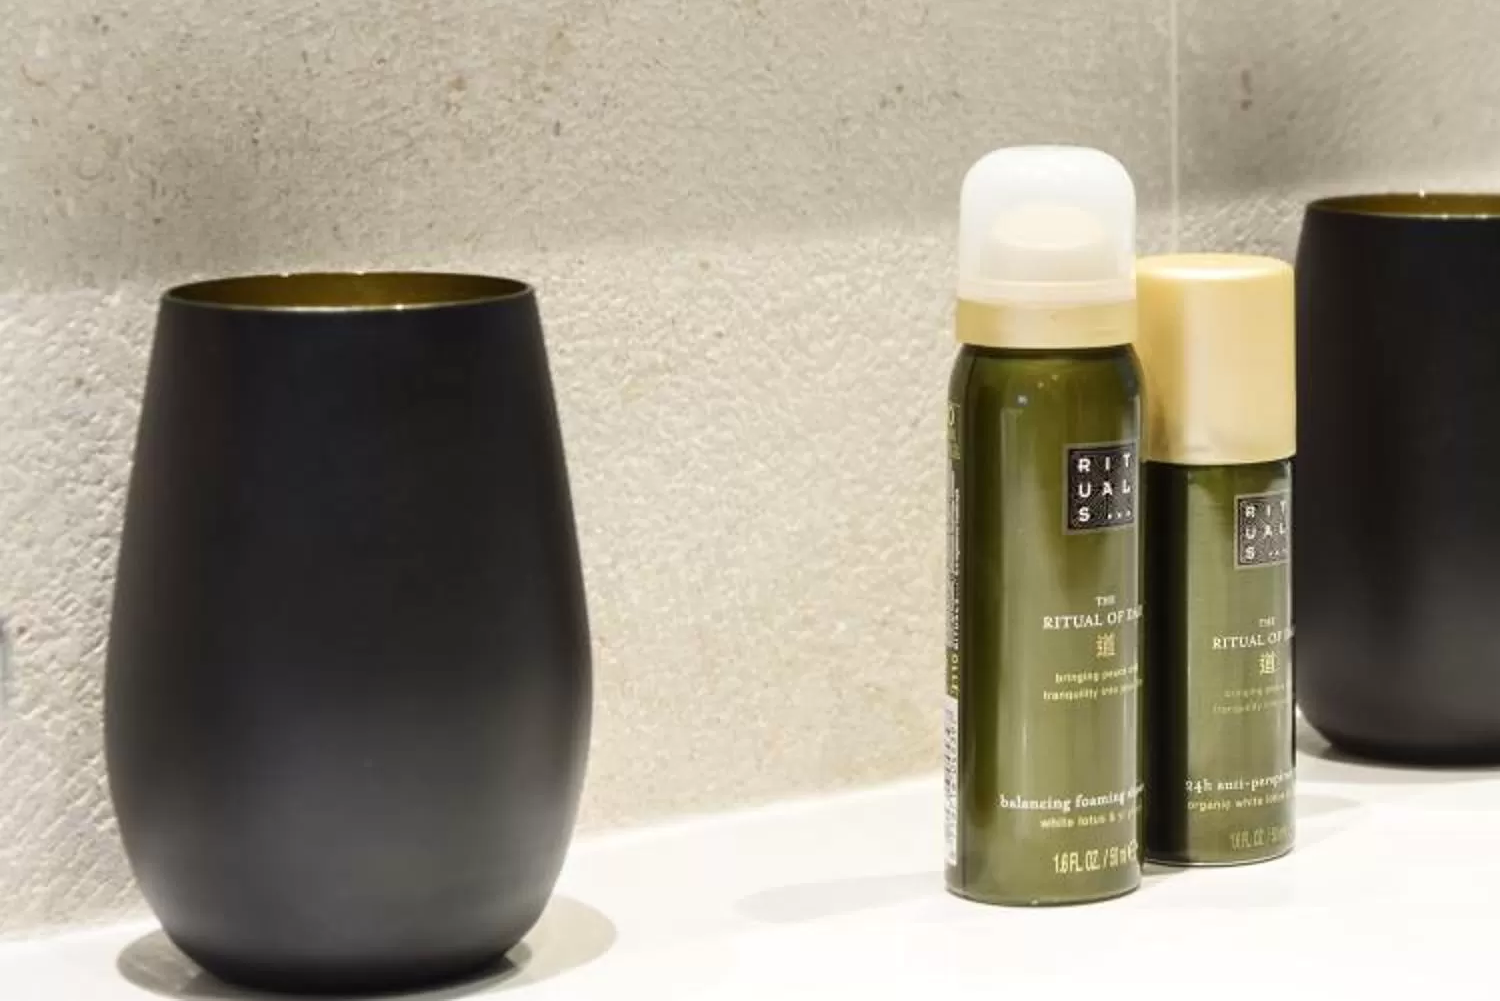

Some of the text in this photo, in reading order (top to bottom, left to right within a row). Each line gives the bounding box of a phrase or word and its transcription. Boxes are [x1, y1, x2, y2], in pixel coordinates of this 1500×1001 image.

[1043, 613, 1103, 630] RITUAL
[1107, 610, 1125, 625] OF
[1212, 634, 1265, 650] RITUAL
[1000, 793, 1071, 813] balancing
[1075, 791, 1125, 808] foaming
